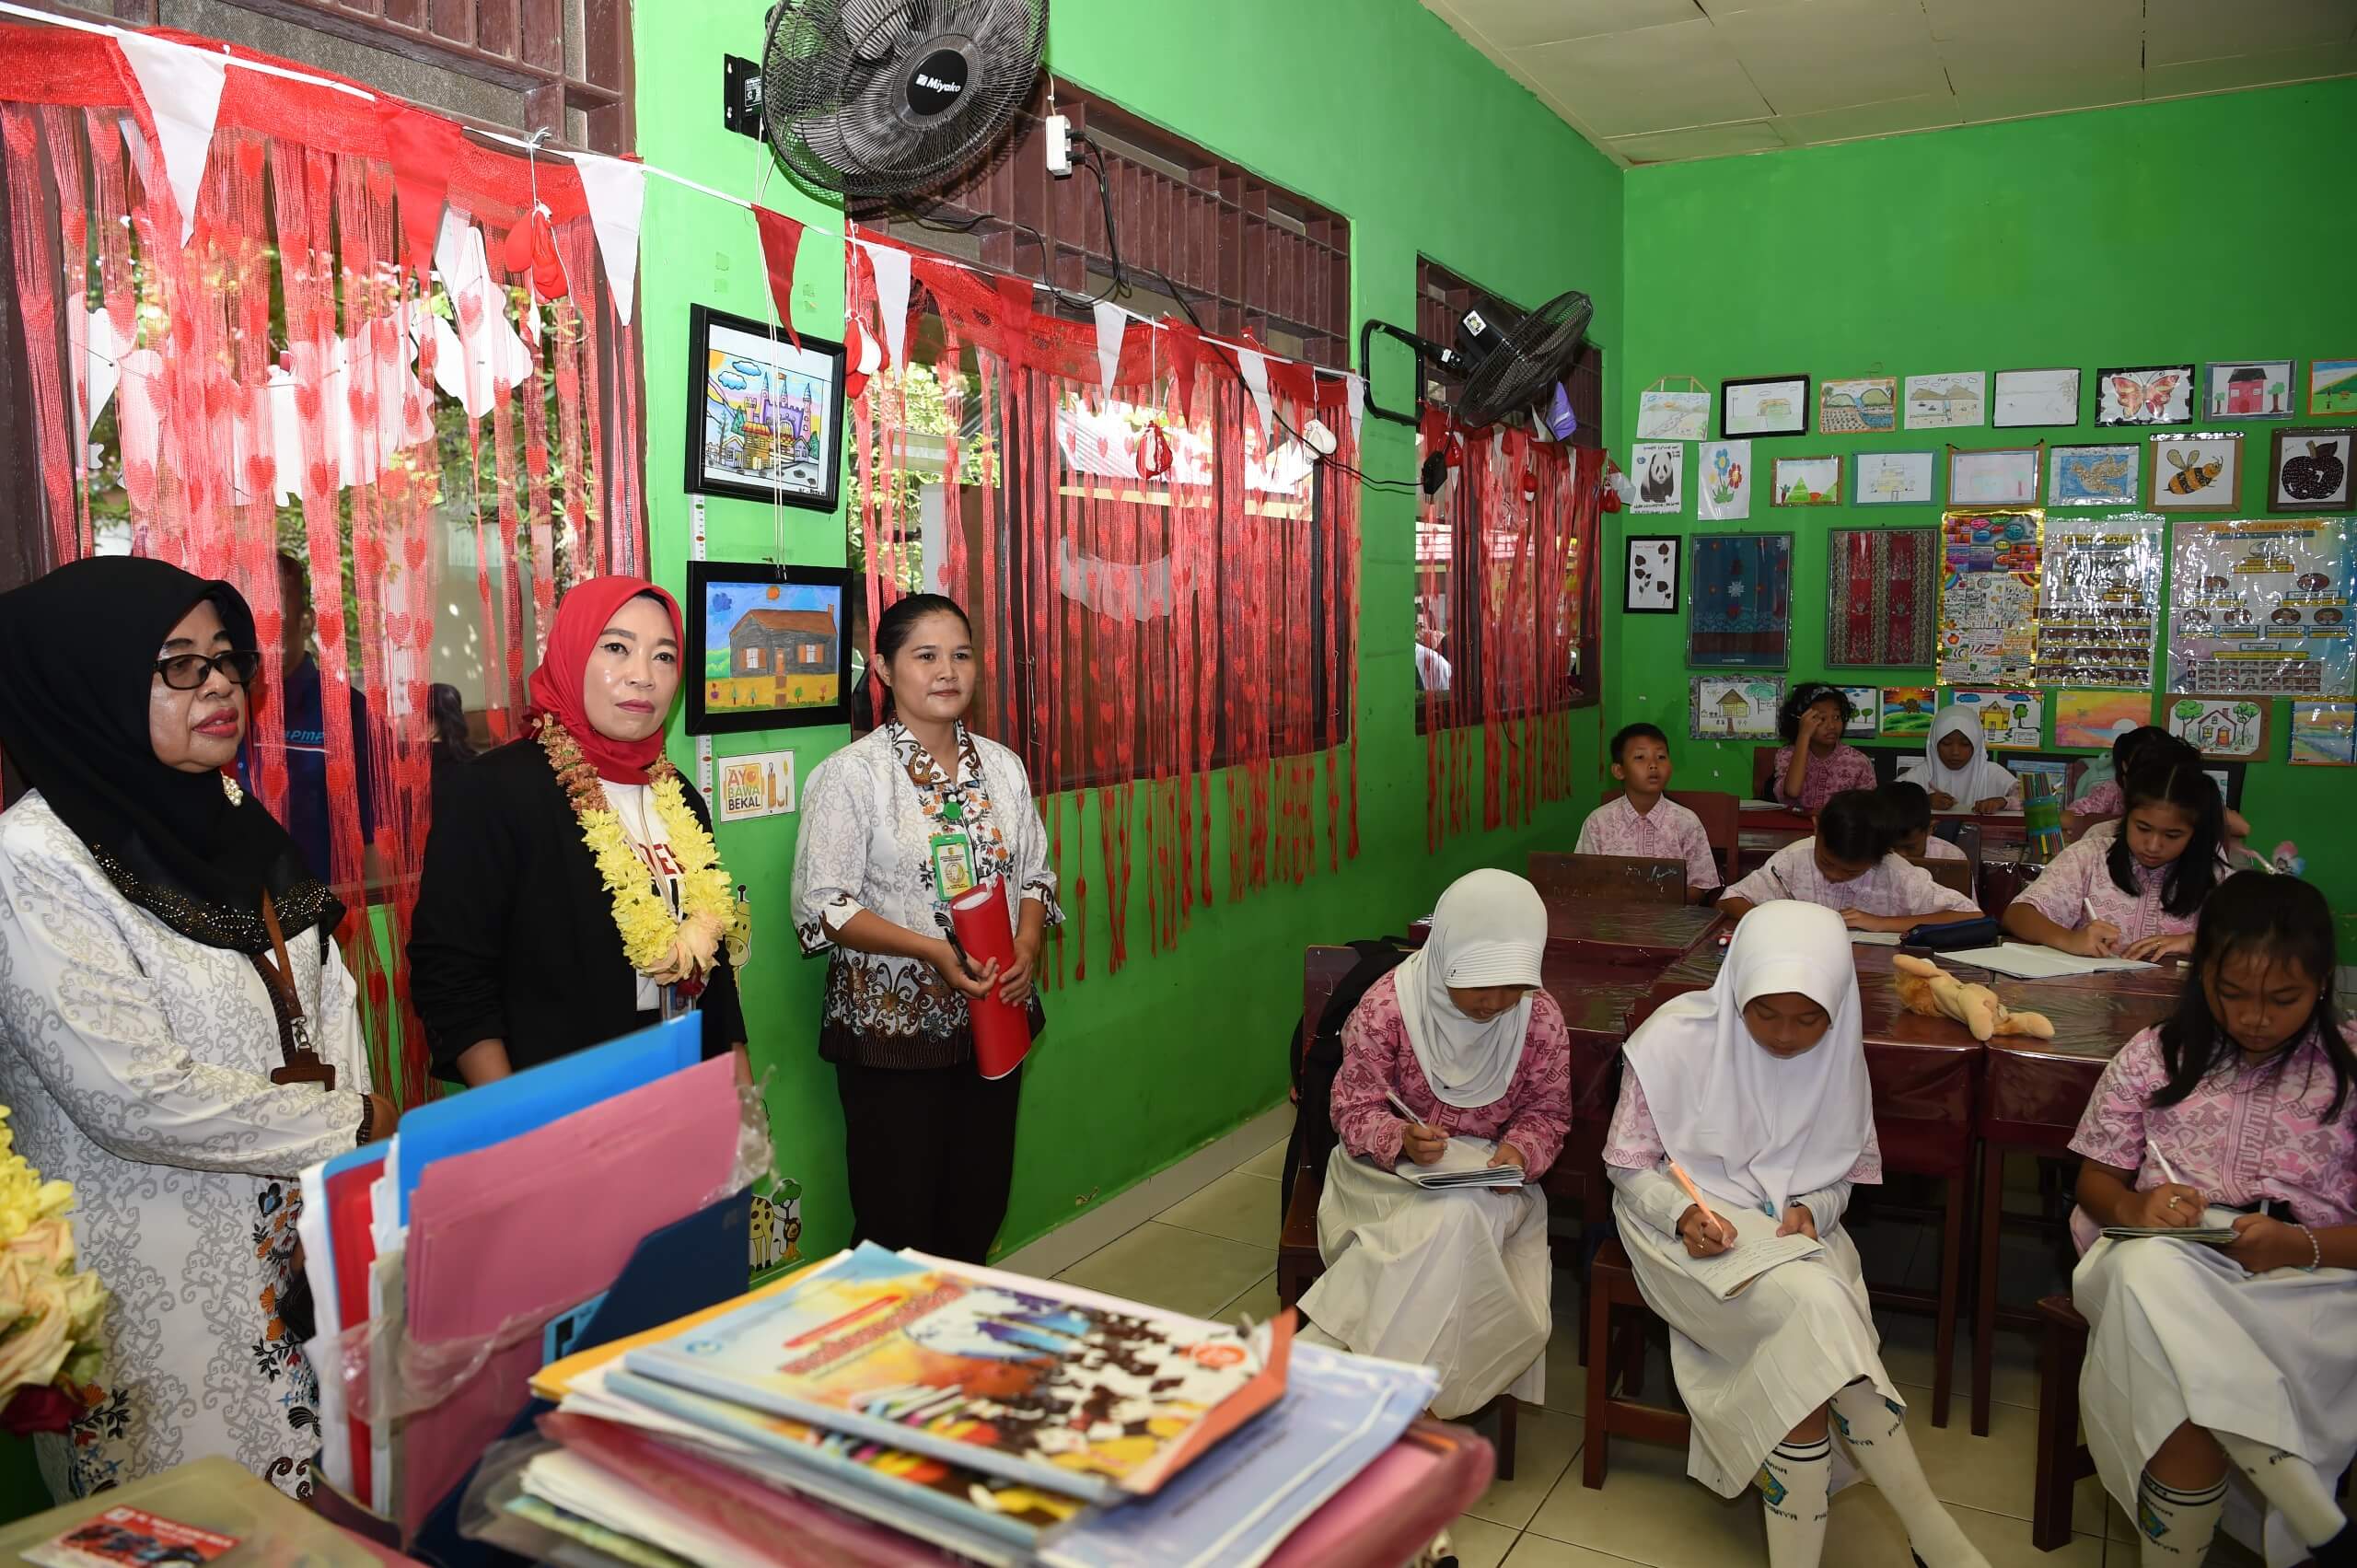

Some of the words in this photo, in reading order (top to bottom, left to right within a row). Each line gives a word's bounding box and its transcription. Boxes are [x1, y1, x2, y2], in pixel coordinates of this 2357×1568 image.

[926, 76, 961, 93] Miyako
[728, 785, 761, 798] BAWA
[728, 796, 761, 811] BEKAL
